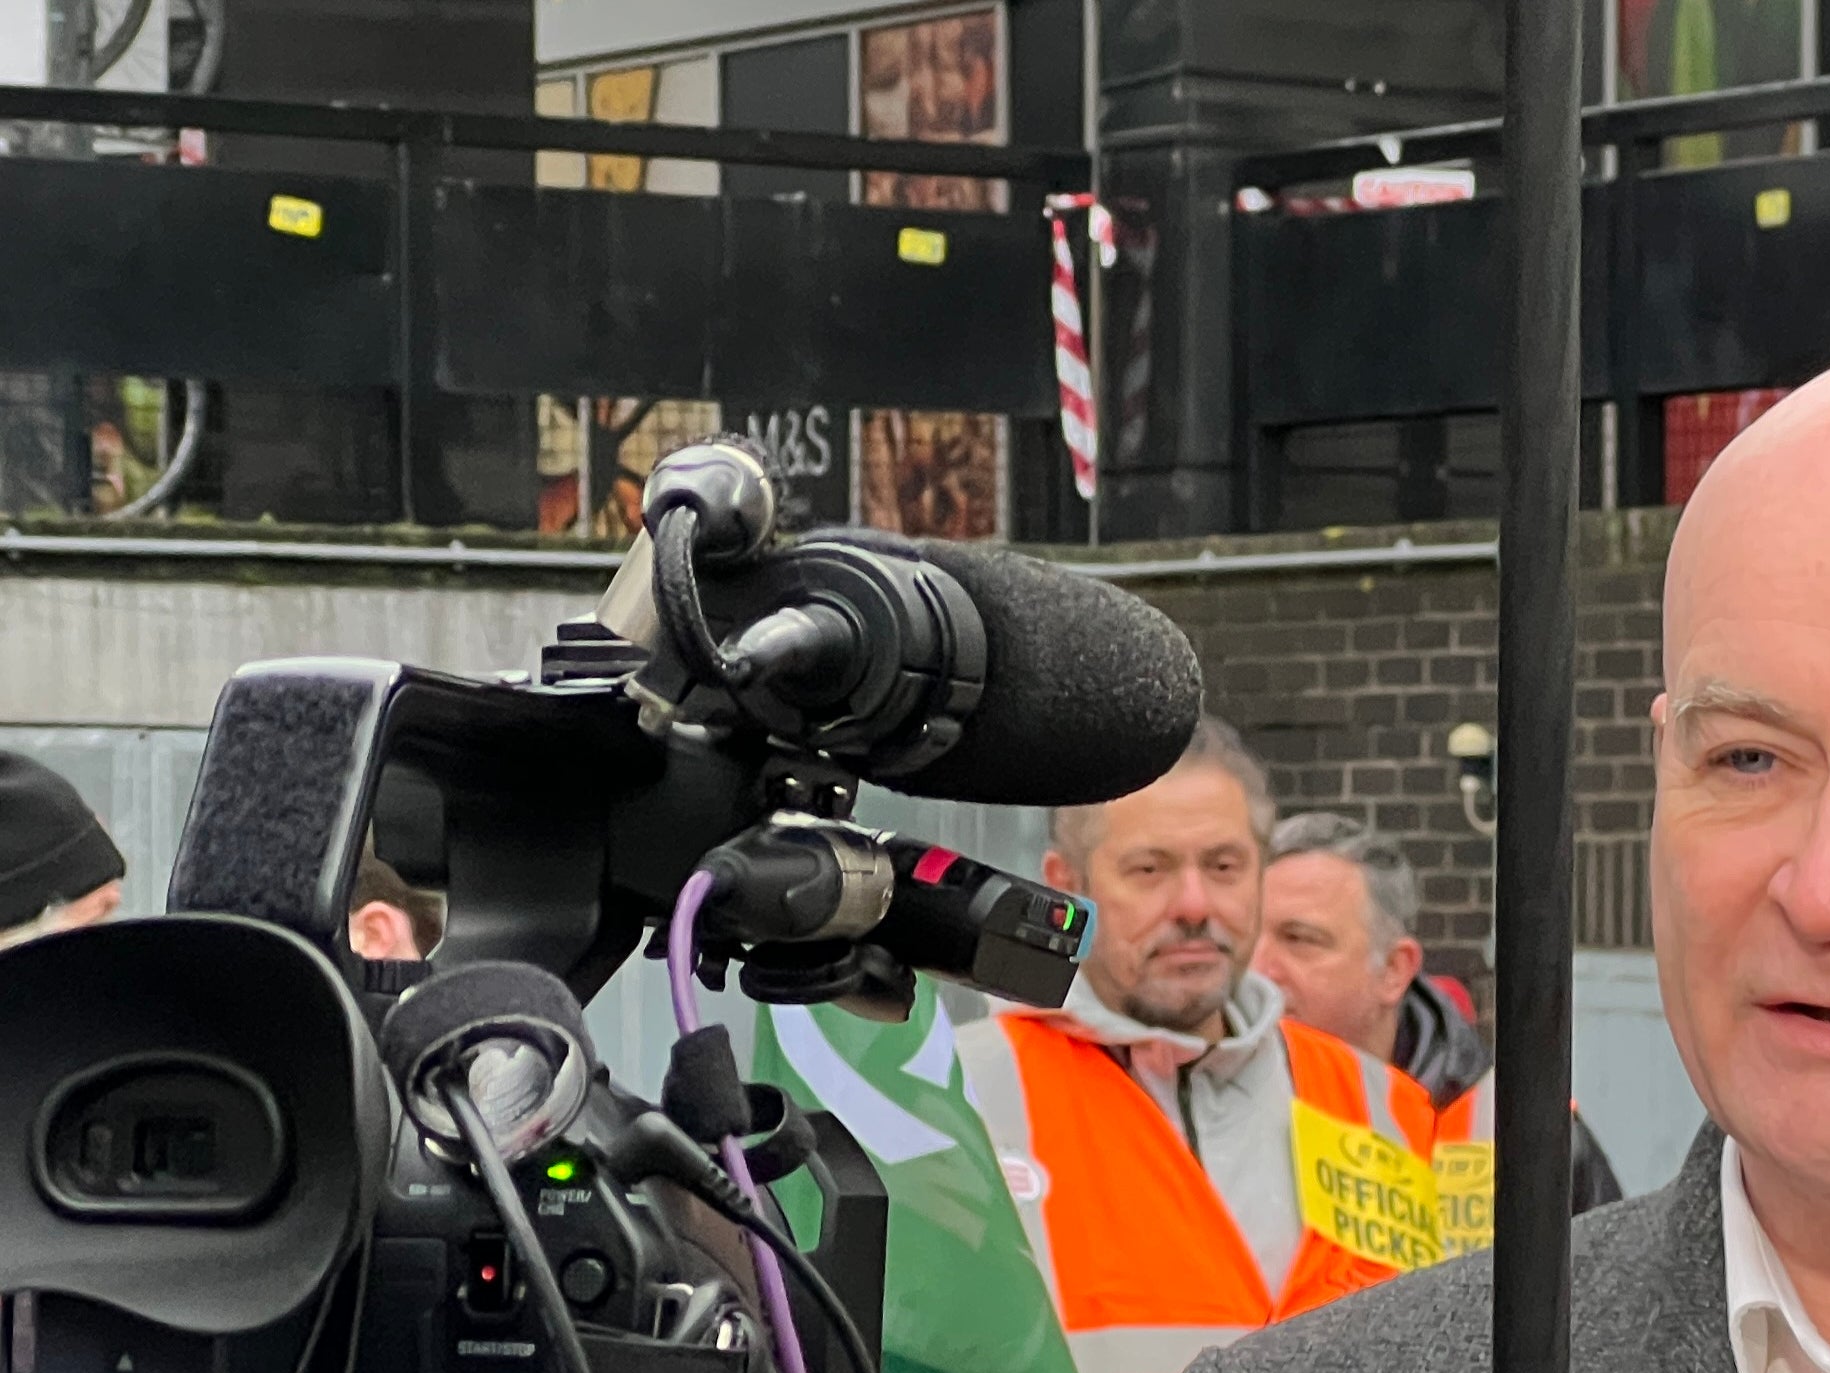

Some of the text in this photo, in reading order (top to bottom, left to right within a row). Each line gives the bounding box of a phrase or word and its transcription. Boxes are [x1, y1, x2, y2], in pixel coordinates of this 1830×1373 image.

[747, 405, 832, 476] M&S
[1316, 1156, 1443, 1248] OFFICIA
[1333, 1206, 1437, 1268] PICKE
